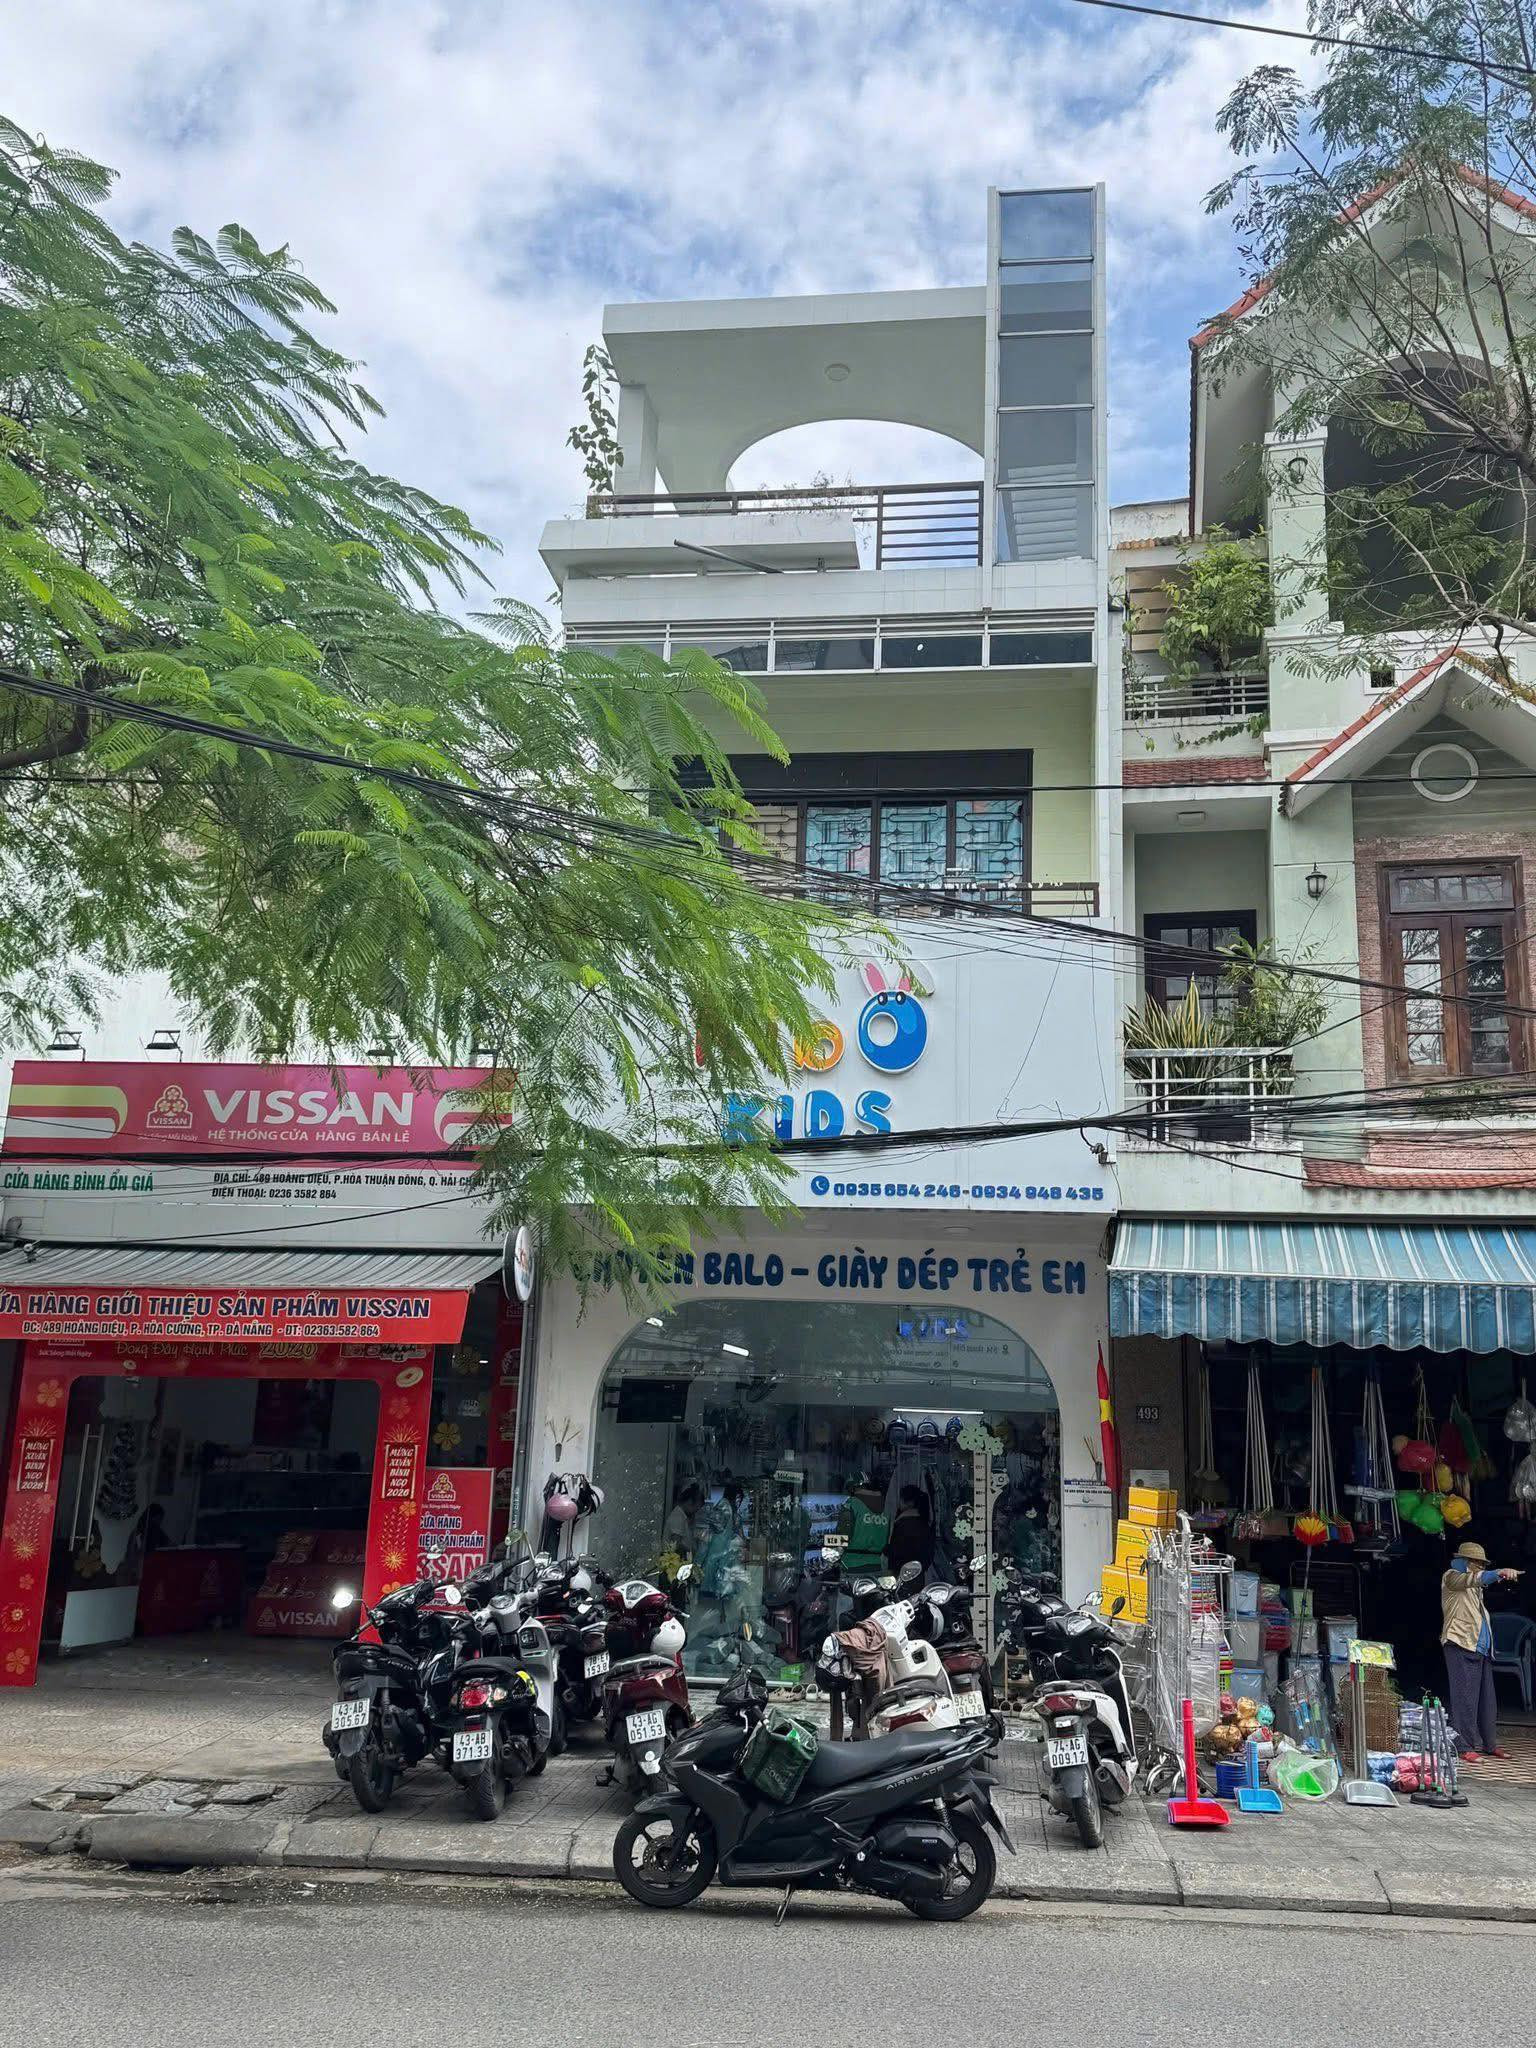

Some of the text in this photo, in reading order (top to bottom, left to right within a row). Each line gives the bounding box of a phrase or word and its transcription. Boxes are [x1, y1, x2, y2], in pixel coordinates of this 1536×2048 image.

[203, 1089, 414, 1126] VISSAN
[152, 1117, 188, 1125] VISSAN
[208, 1126, 410, 1143] HỆ THỐNG CỬA HÀNG BÁN LẺ
[4, 1166, 154, 1192] CỬA HÀNG BÌNH ỔN GIÁ
[254, 1173, 271, 1184] 489
[272, 1171, 305, 1184] HOÀNG
[365, 1173, 394, 1187] THUẬN
[398, 1173, 426, 1187] ĐÔNG,
[429, 1176, 438, 1186] Q.
[441, 1172, 457, 1186] HẢI
[212, 1185, 234, 1199] ĐIỆN
[237, 1187, 267, 1200] THOẠI:
[269, 1188, 292, 1198] 0236
[294, 1189, 318, 1199] 3582
[834, 1182, 881, 1197] 0935
[884, 1183, 921, 1197] 654
[1025, 1186, 1062, 1201] 948
[1065, 1186, 1104, 1201] 435
[703, 1252, 783, 1287] BALO
[817, 1246, 888, 1289] GIÀY
[897, 1247, 959, 1291] DÉP
[967, 1247, 1032, 1293] TRẺ
[1041, 1259, 1085, 1295] EM
[27, 1291, 90, 1316] HÀNG
[95, 1290, 142, 1316] GIỚI
[148, 1292, 212, 1323] THIỆU
[217, 1290, 266, 1318] SẢN
[271, 1289, 340, 1318] PHẨM
[346, 1298, 430, 1319] VISSAN
[23, 1321, 39, 1334] ĐC:
[43, 1321, 61, 1334] 489
[63, 1319, 98, 1335] HOÀNG
[101, 1320, 128, 1337] DIỆU,
[131, 1323, 141, 1335] P.
[143, 1320, 162, 1335] HÒA
[166, 1319, 205, 1337] CƯỜNG,
[207, 1323, 225, 1336] TP.
[225, 1321, 240, 1336] ĐÀ
[242, 1320, 272, 1337] NẴNG
[284, 1324, 302, 1337] ĐT:
[304, 1324, 358, 1337] 02363.582
[360, 1324, 380, 1338] 864
[1137, 1407, 1158, 1421] 493
[21, 1481, 44, 1490] 2026
[386, 1488, 410, 1497] 2026
[437, 1514, 462, 1530] HÀNG
[863, 1512, 888, 1526] Grab
[457, 1530, 484, 1549] PHẨM
[278, 1611, 339, 1626] VISSAN
[338, 1701, 364, 1716] 43-AB
[333, 1712, 367, 1729] 305.67
[631, 1712, 658, 1729] 43-AG
[459, 1732, 486, 1747] 43-AB
[630, 1724, 663, 1741] 051.53
[455, 1745, 489, 1760] 371.33
[1053, 1738, 1081, 1754] 74-AG
[1052, 1750, 1086, 1767] 009.12
